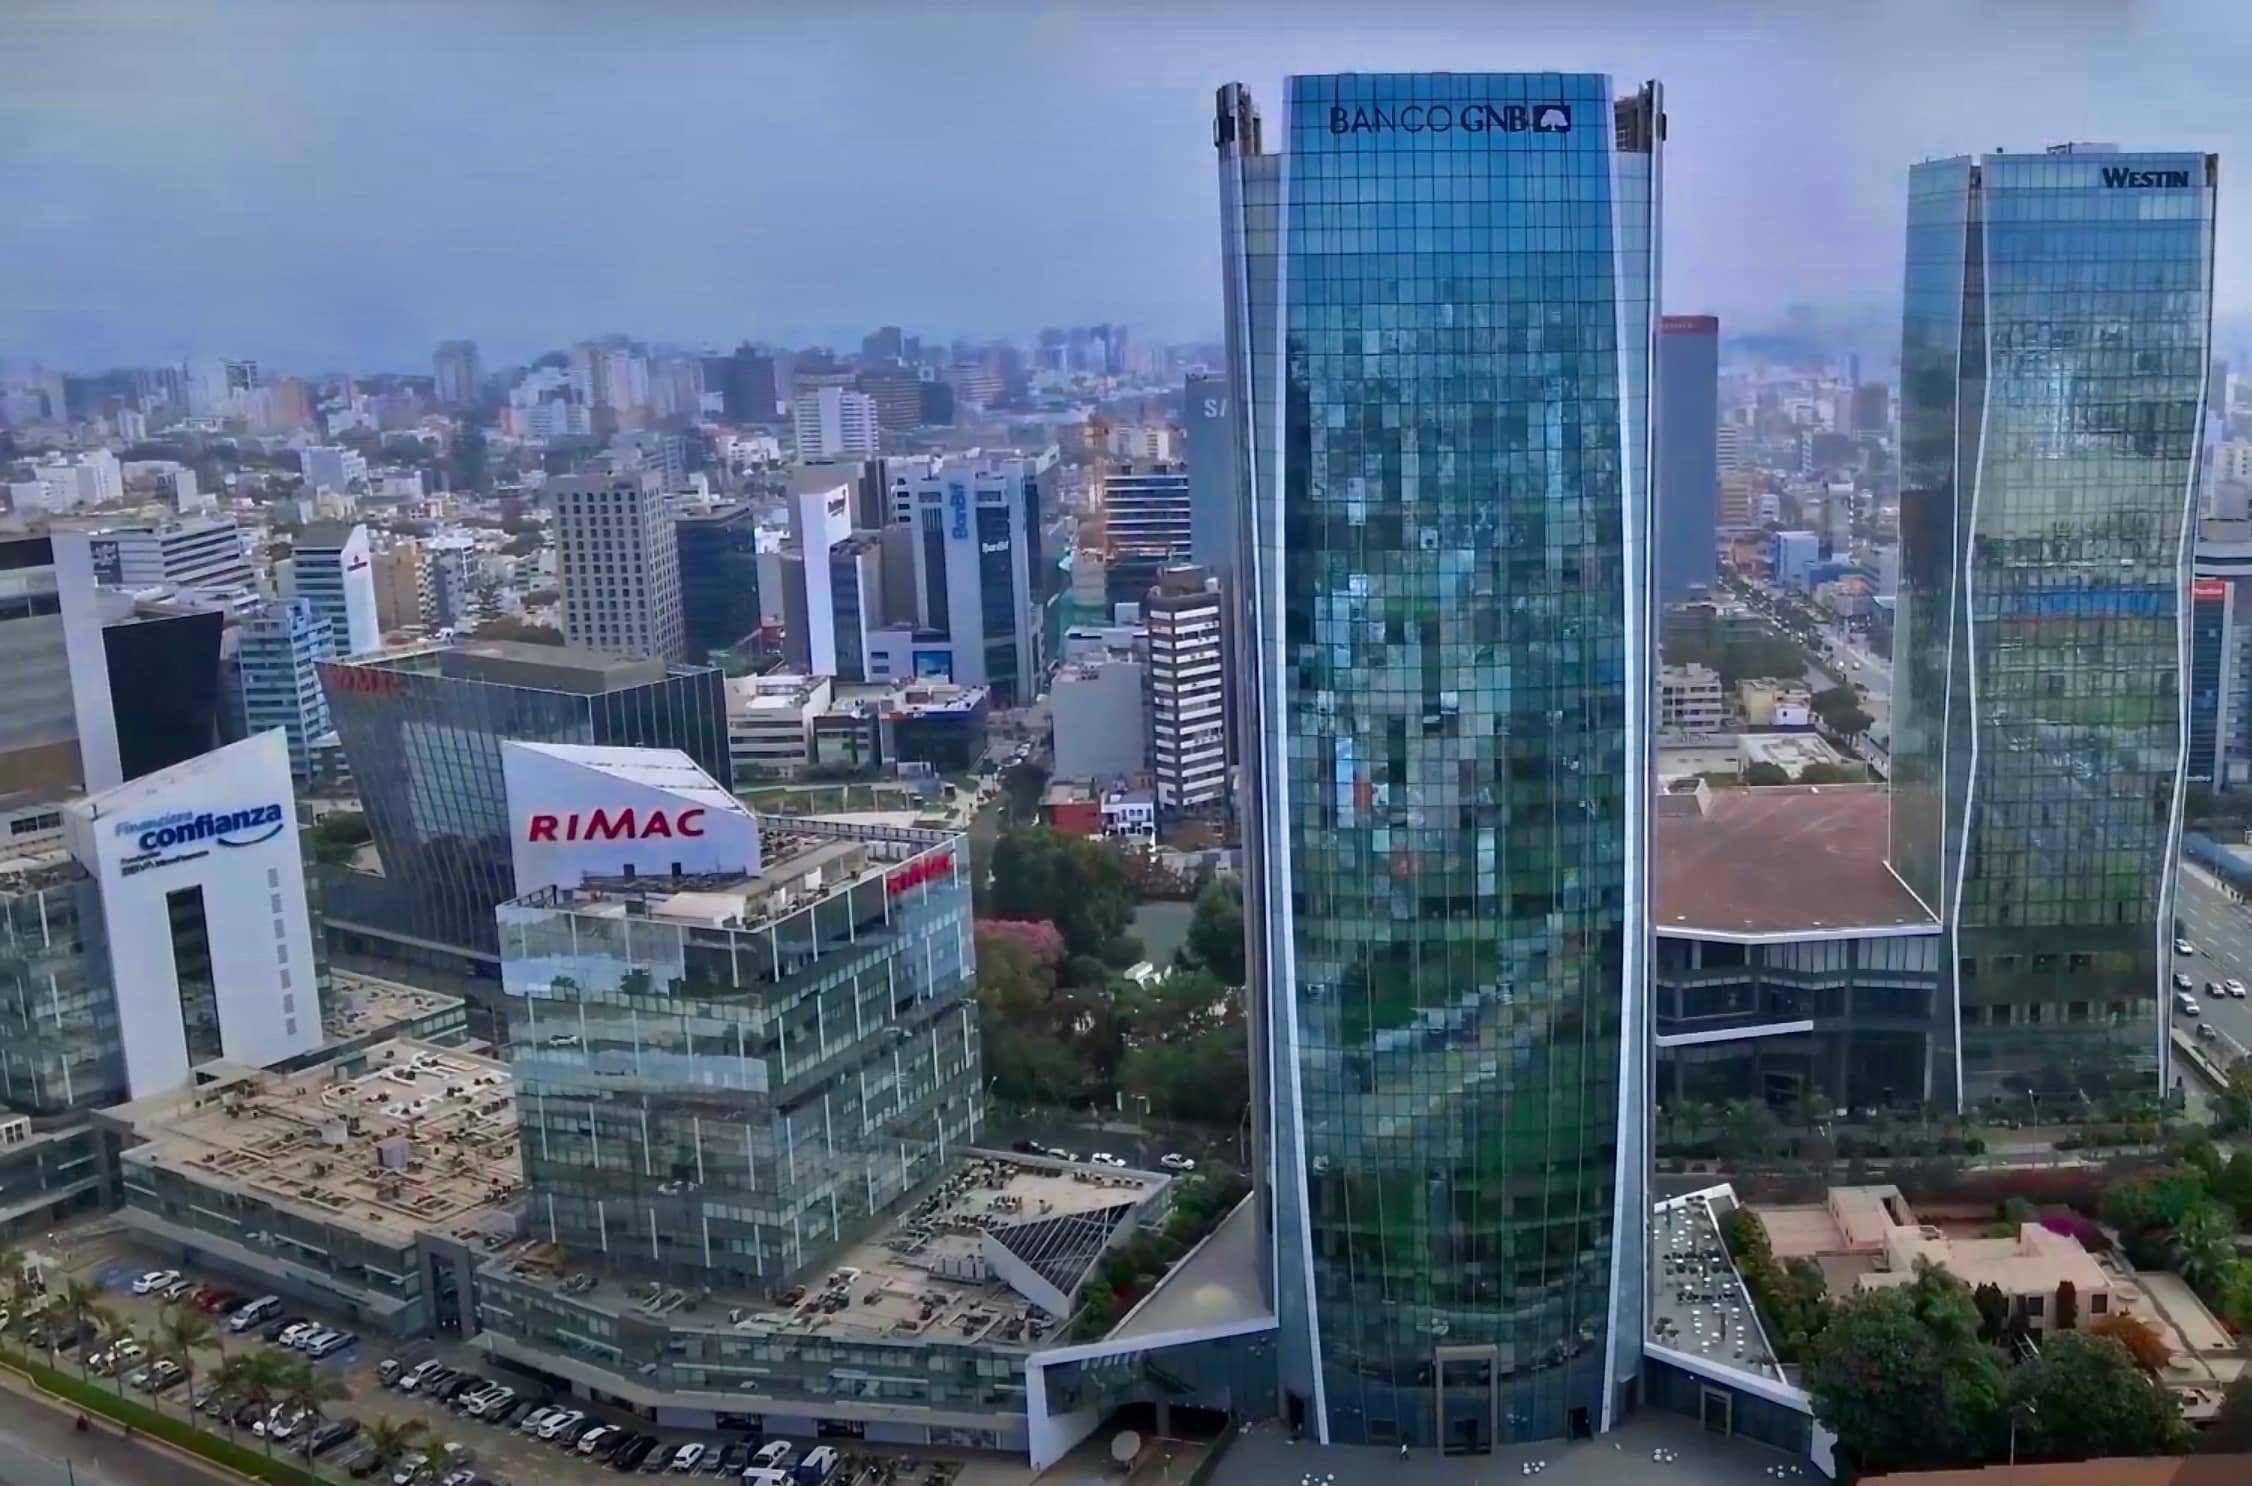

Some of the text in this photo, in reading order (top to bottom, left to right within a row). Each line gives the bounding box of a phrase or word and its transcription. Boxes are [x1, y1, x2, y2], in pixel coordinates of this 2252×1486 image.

[1329, 104, 1528, 134] BANCO GNB
[138, 803, 284, 850] confianza
[528, 807, 705, 842] RIMAC
